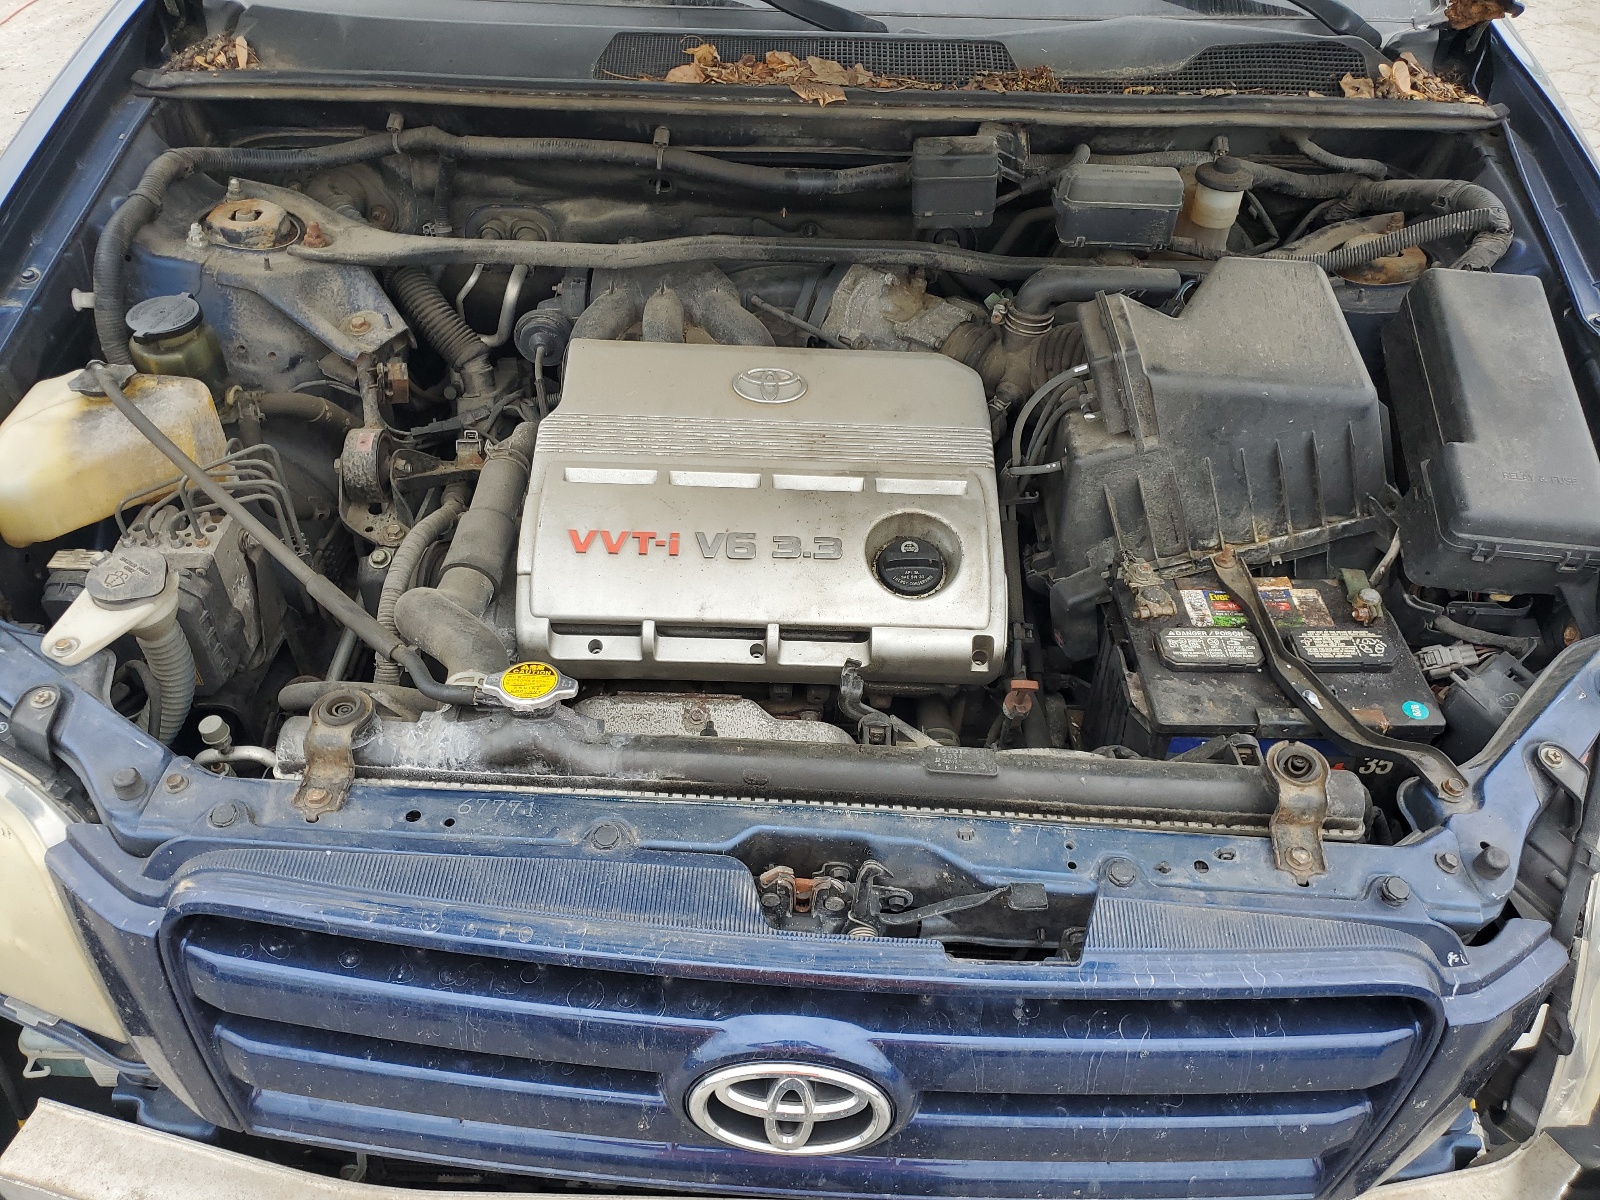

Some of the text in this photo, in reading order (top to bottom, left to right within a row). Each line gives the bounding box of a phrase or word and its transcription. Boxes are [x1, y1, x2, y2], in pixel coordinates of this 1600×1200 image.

[1502, 472, 1534, 481] RELAY
[1551, 476, 1578, 485] FUSE
[568, 528, 843, 560] VVT-i V6 3.3
[1358, 757, 1394, 775] 35
